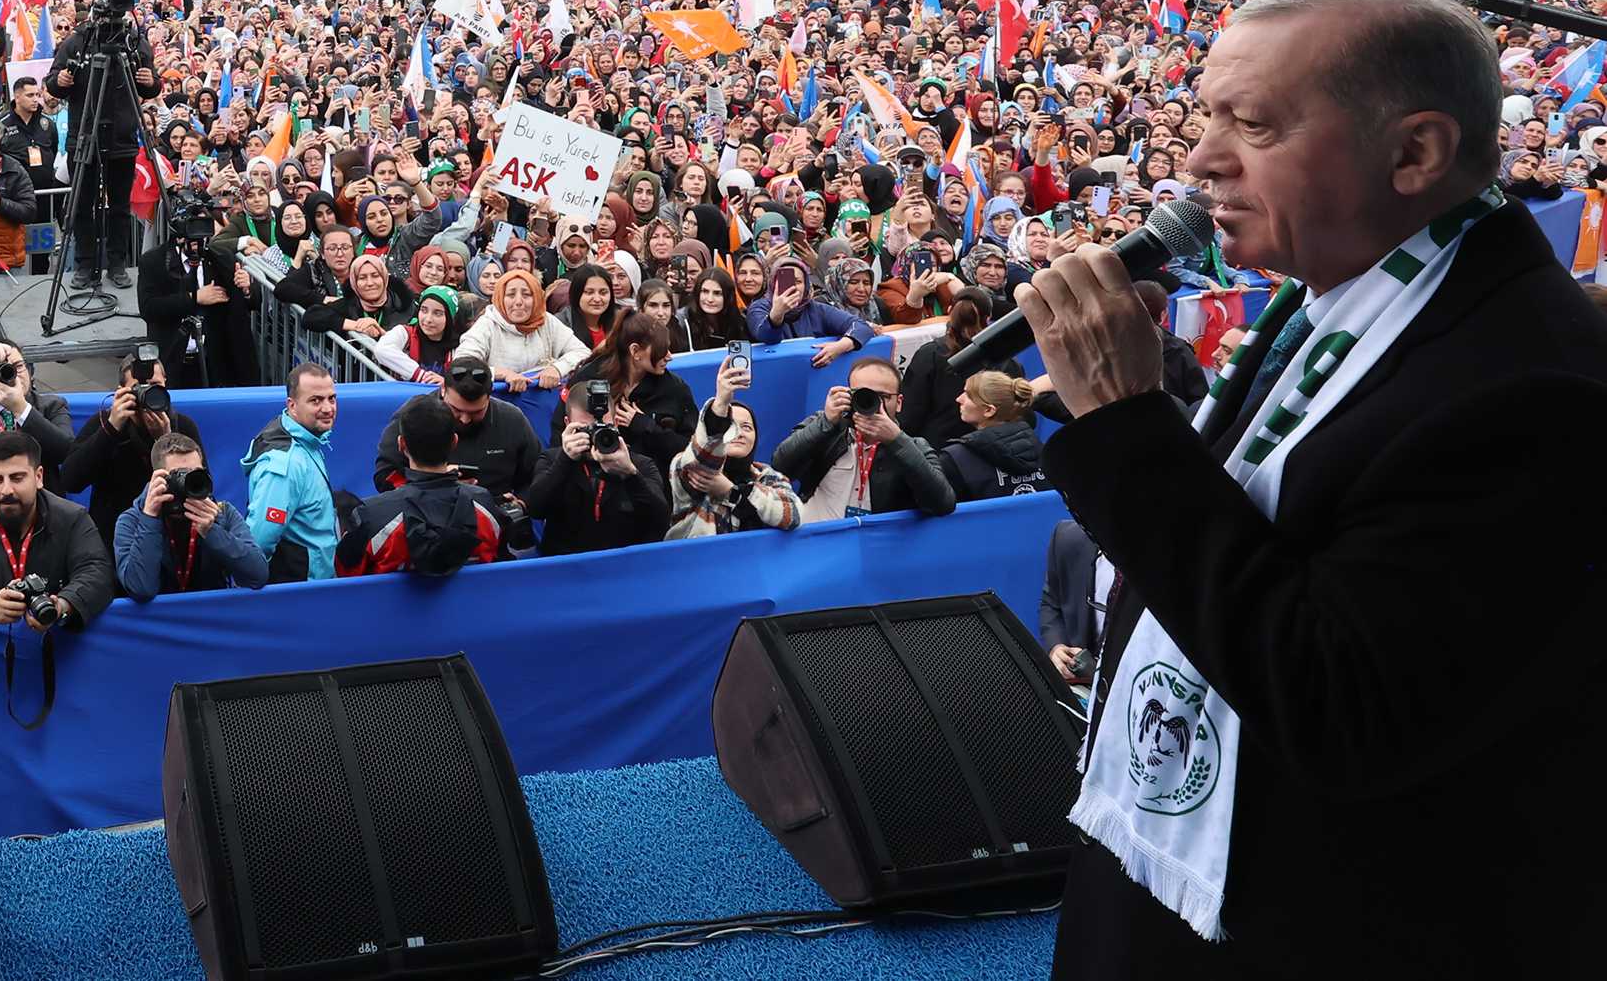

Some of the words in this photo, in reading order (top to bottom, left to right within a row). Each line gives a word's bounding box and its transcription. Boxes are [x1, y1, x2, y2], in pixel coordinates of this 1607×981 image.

[514, 114, 535, 139] Bu
[972, 847, 990, 860] d&b
[358, 941, 378, 955] d&b
